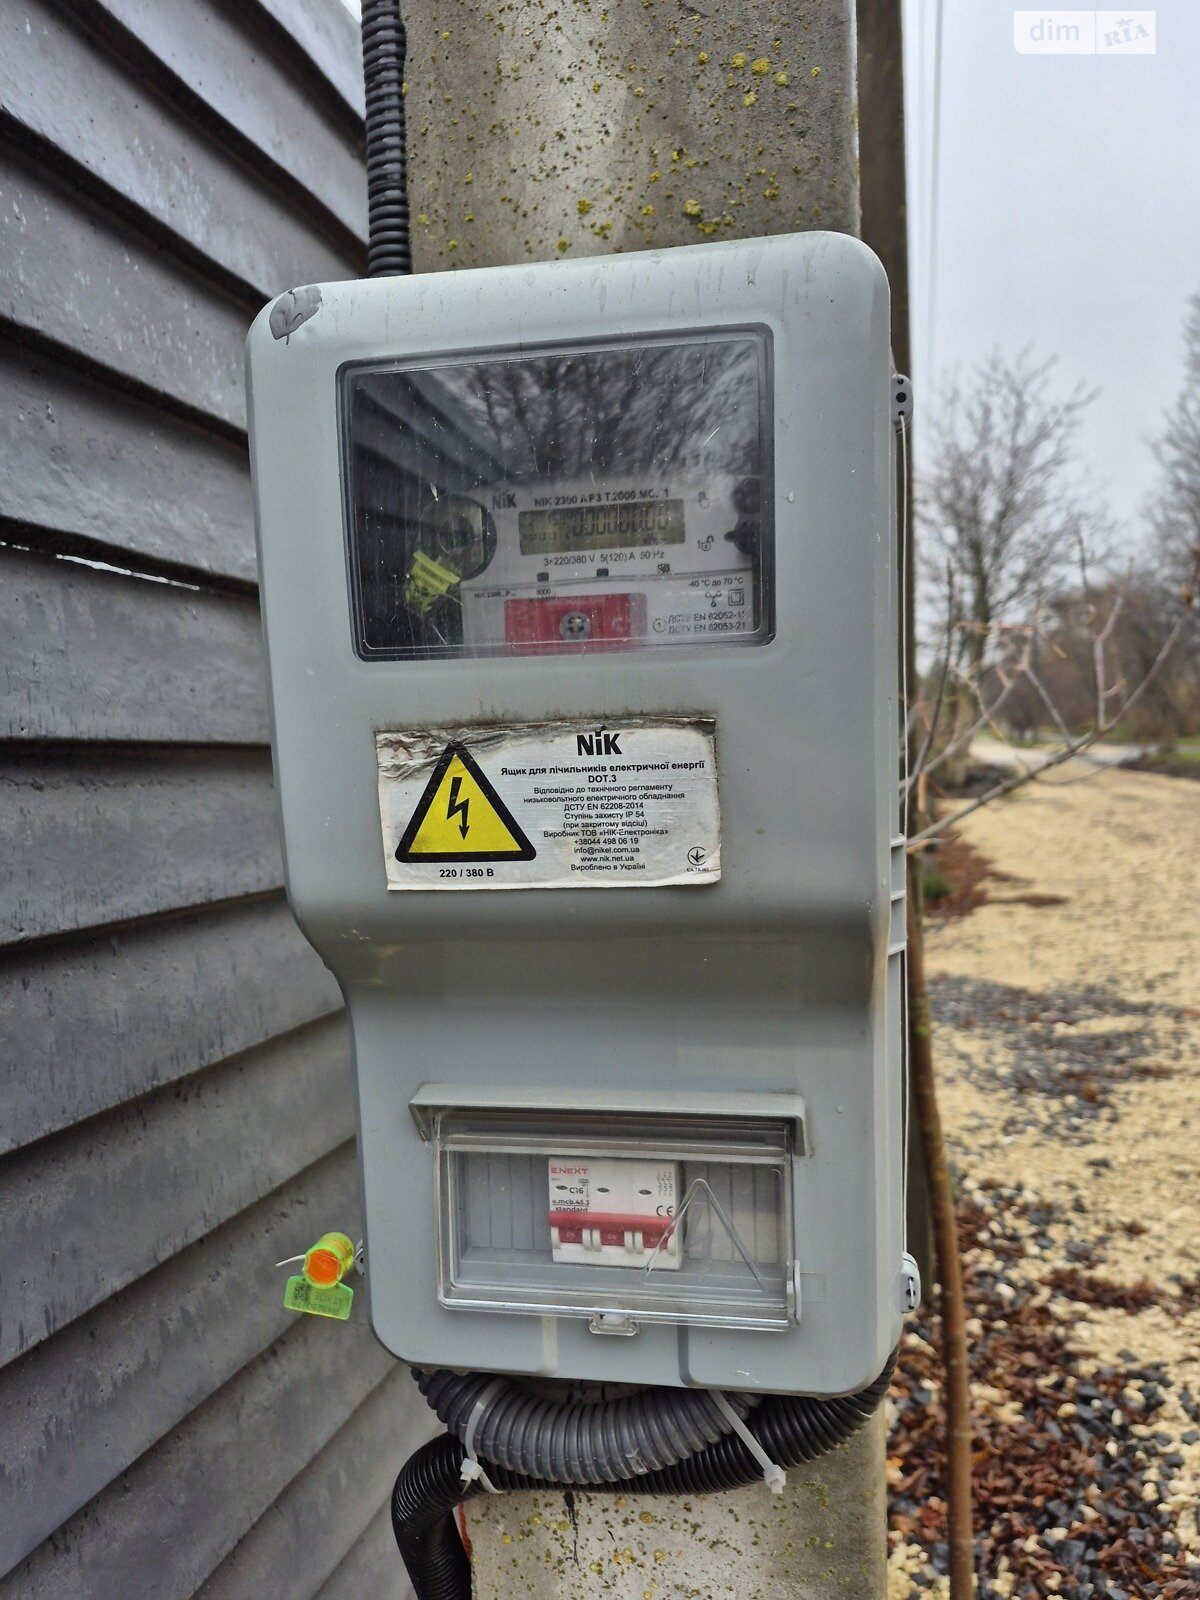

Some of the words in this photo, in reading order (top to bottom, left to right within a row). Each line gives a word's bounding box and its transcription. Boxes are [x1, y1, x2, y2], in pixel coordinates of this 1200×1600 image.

[554, 495, 578, 506] 2300
[589, 554, 596, 564] V
[629, 552, 636, 561] A
[640, 550, 651, 560] 50
[653, 549, 665, 560] Hz
[723, 577, 733, 586] 70
[693, 612, 706, 621] EN
[693, 622, 706, 632] EN
[576, 727, 622, 756] NiK
[501, 767, 527, 777] Ящик
[529, 767, 547, 776] для
[549, 763, 607, 774] лічильників
[609, 761, 670, 772] електричної
[671, 760, 705, 770] енергії
[588, 774, 617, 784] DOT.3
[533, 787, 575, 795] Відповідно
[588, 785, 627, 793] технічного
[628, 784, 673, 793] регламенту
[523, 796, 585, 804] низьковольтного
[586, 794, 637, 803] електричного
[638, 792, 685, 801] обладнання
[563, 803, 586, 812] ДСТУ
[587, 803, 599, 811] EN
[600, 802, 644, 810] 62208-2014
[564, 812, 594, 821] Ступінь
[594, 812, 624, 820] захисту
[635, 810, 645, 818] 54
[562, 822, 580, 830] (при
[581, 821, 620, 829] закритому
[543, 830, 580, 838] Виробник
[581, 829, 598, 837] ТОВ
[618, 837, 628, 845] 06
[630, 837, 639, 845] 19
[573, 846, 640, 856] info@nikel.com.ua
[580, 855, 635, 863] www.nik.net.ua
[570, 863, 612, 871] Вироблено
[619, 862, 646, 871] Україні
[439, 869, 458, 878] 220
[466, 868, 484, 878] 380
[486, 868, 495, 877] В
[569, 1186, 584, 1195] C16
